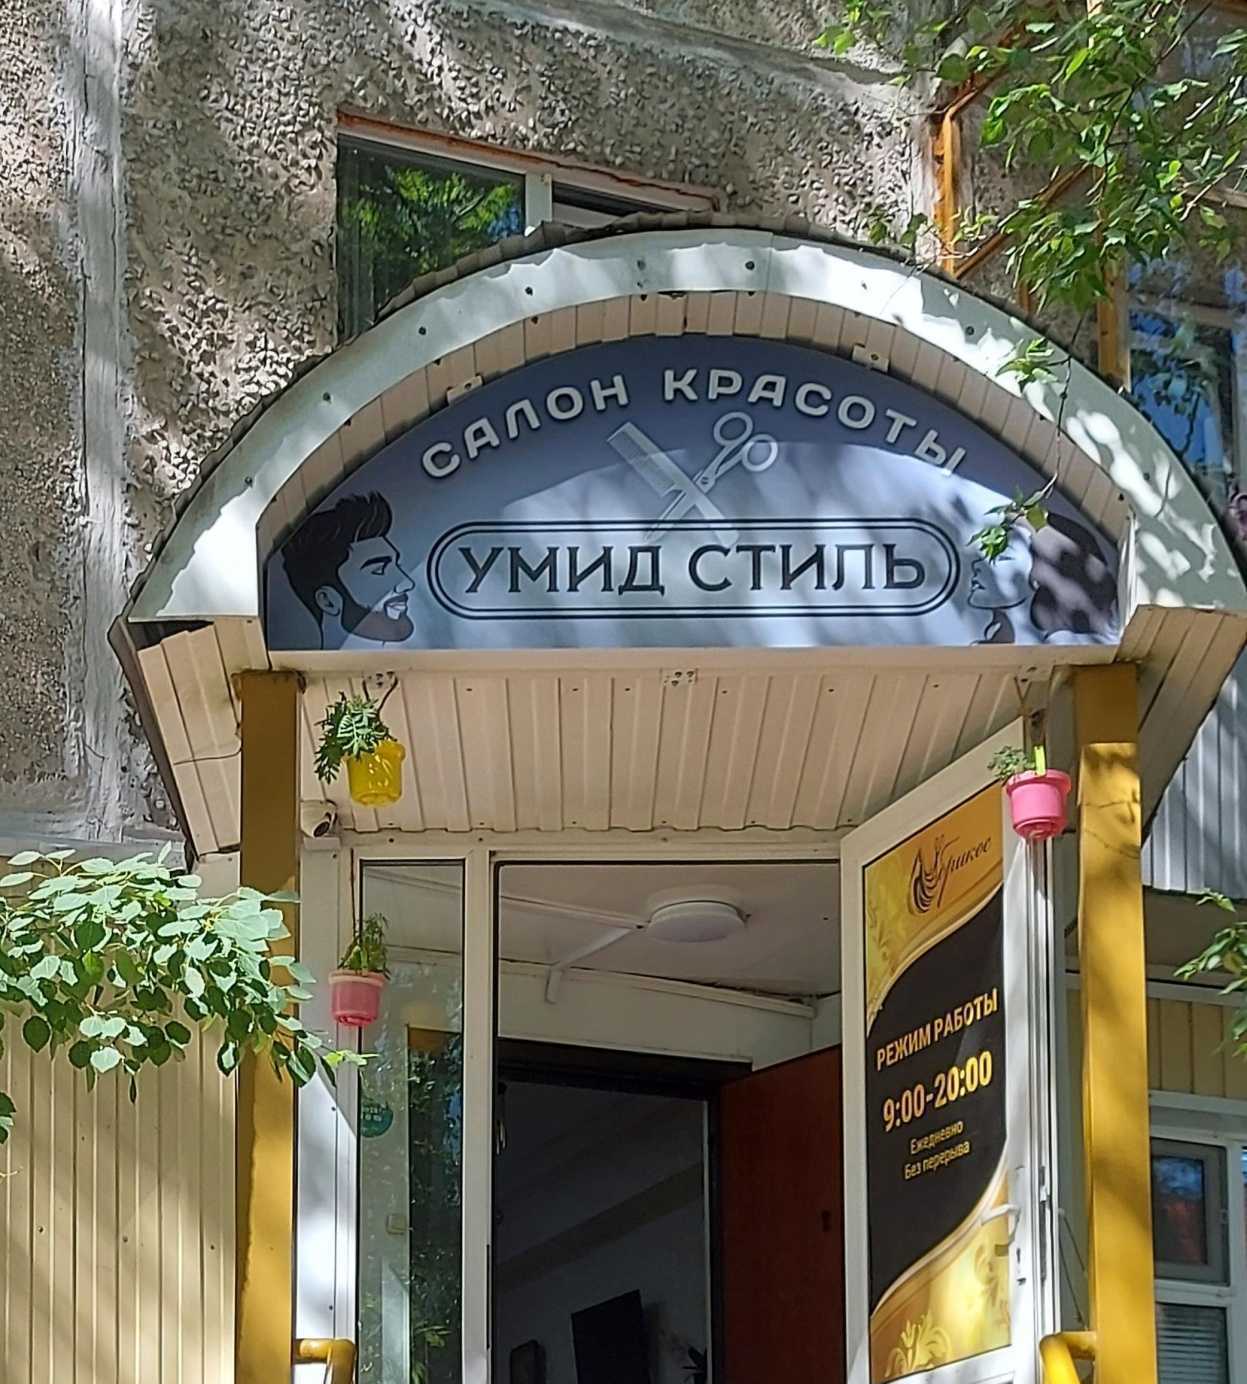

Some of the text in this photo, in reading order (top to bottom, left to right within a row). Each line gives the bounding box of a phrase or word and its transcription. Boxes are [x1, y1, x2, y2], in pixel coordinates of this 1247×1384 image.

[421, 368, 967, 480] САЛОН КРАСОТЫ
[458, 543, 926, 597] УМИД СТИЛЬ
[876, 987, 998, 1072] РЕЖИМ РАБОТЫ
[883, 1050, 993, 1132] 9:00-20:00
[904, 1140, 971, 1181] Без перерыва
[910, 1120, 964, 1155] Ежедневно
